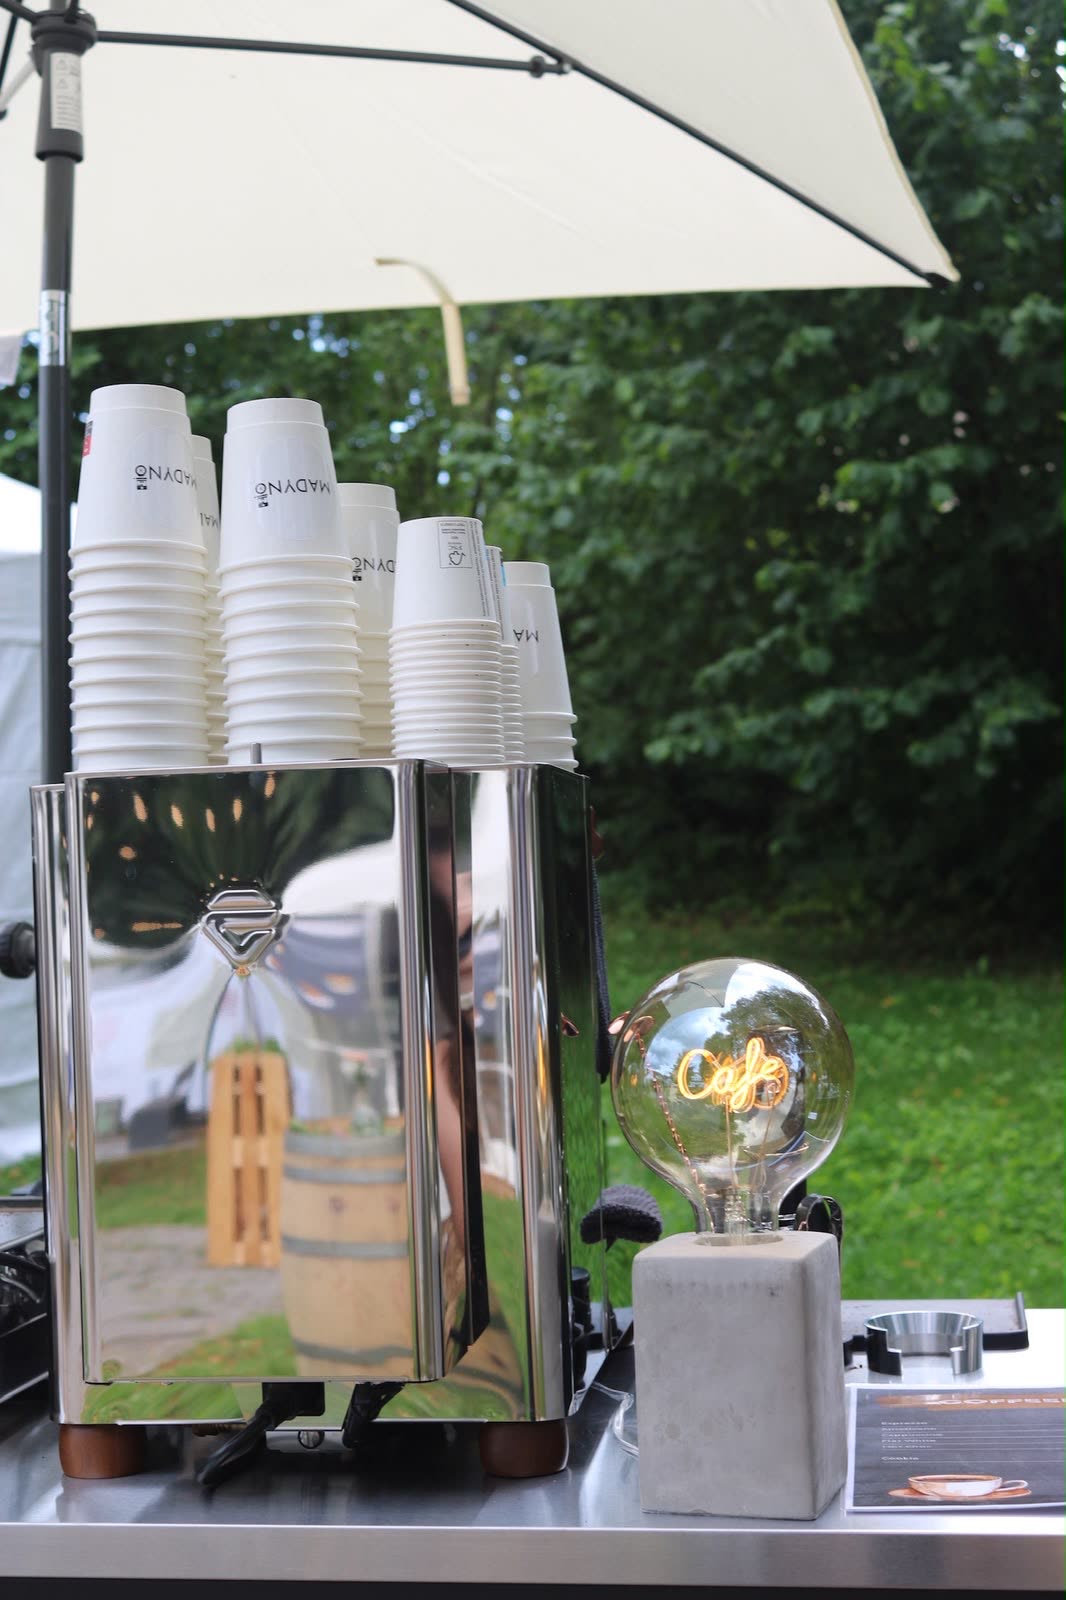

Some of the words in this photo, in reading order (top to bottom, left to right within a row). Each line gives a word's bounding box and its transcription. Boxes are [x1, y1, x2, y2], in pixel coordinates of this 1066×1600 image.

[135, 464, 198, 490] MADYNO
[255, 478, 331, 496] MADYNO
[677, 1036, 787, 1113] Cafe
[939, 1397, 1064, 1405] COFFEE
